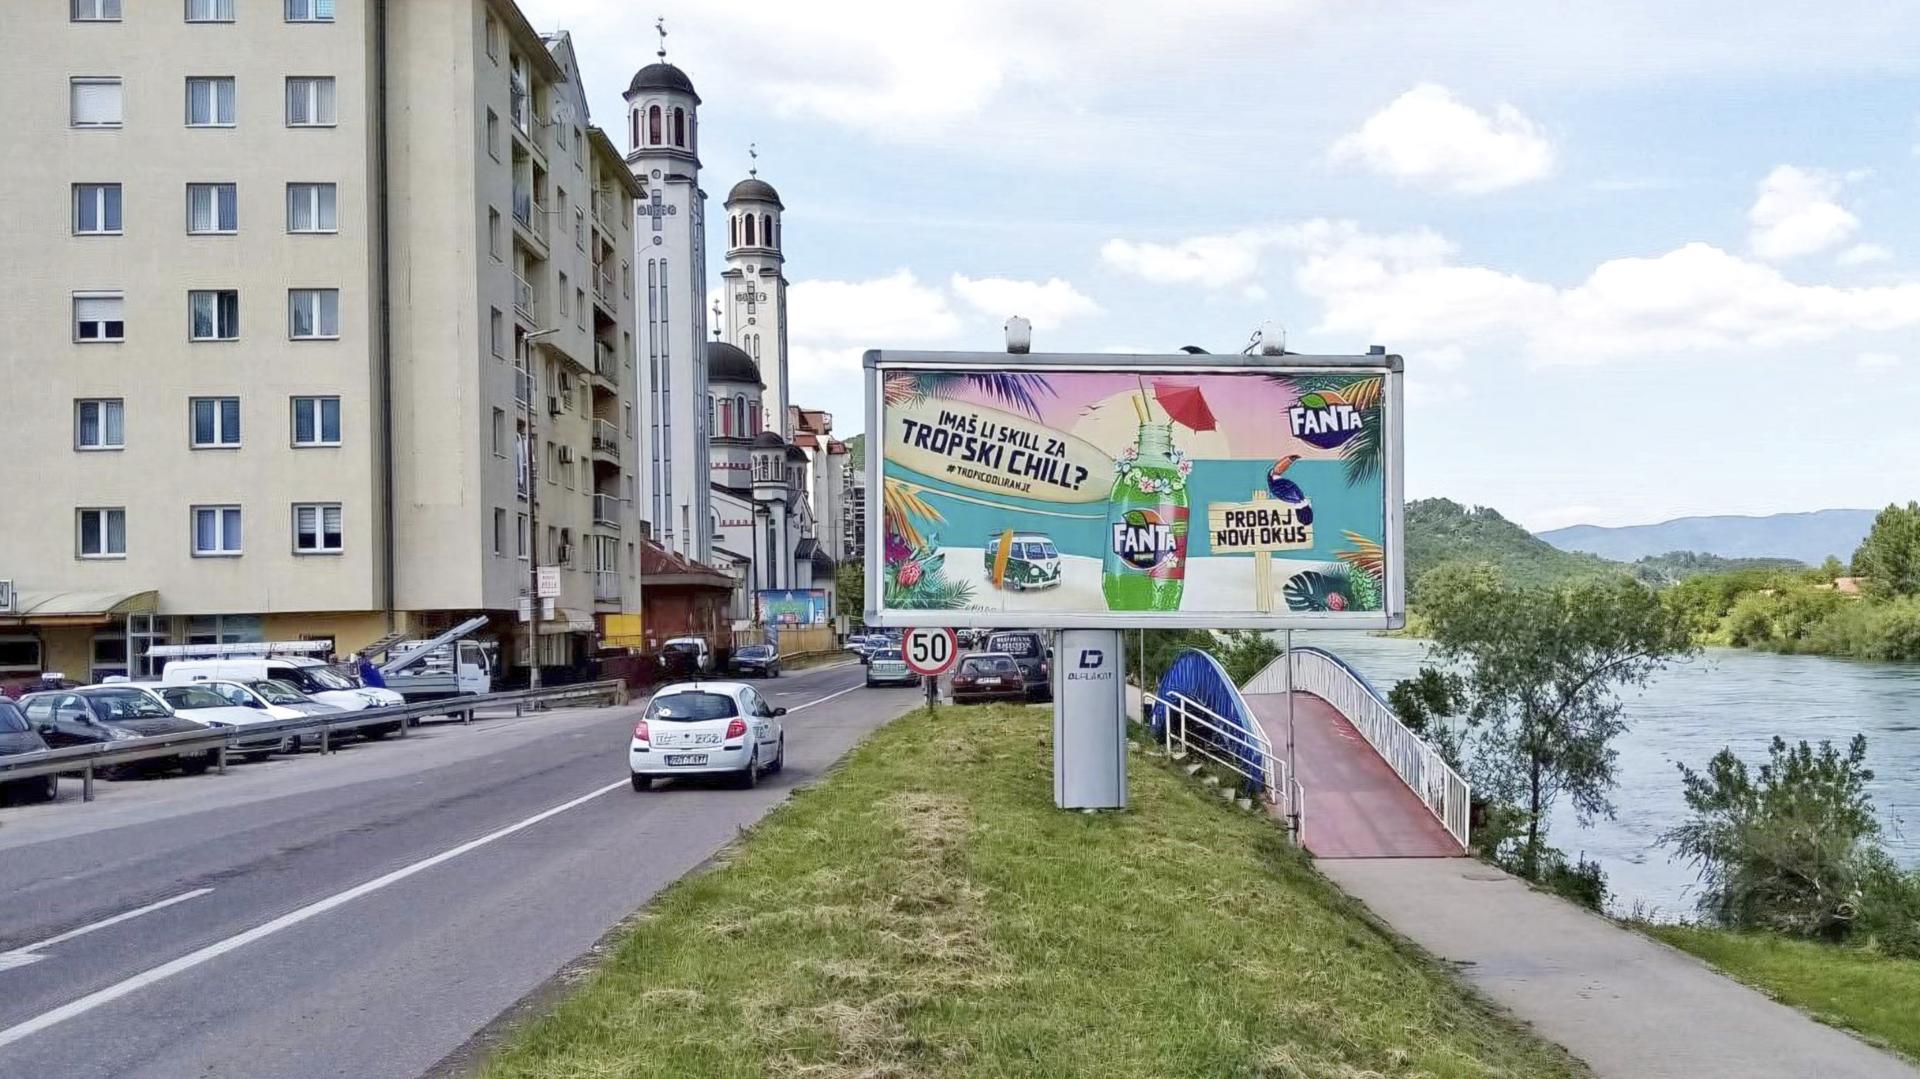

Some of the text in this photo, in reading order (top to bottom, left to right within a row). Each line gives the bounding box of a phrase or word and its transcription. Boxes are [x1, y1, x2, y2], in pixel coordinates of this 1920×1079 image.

[938, 410, 1066, 458] IMAŠ LI SKILL ZA
[1290, 405, 1363, 436] FANTA
[902, 418, 1089, 491] TROPSKI CHILL?
[1225, 508, 1292, 528] PROBAJ
[1113, 523, 1177, 552] FANTA
[1217, 525, 1307, 546] NOVI OKUS
[912, 633, 947, 663] 50
